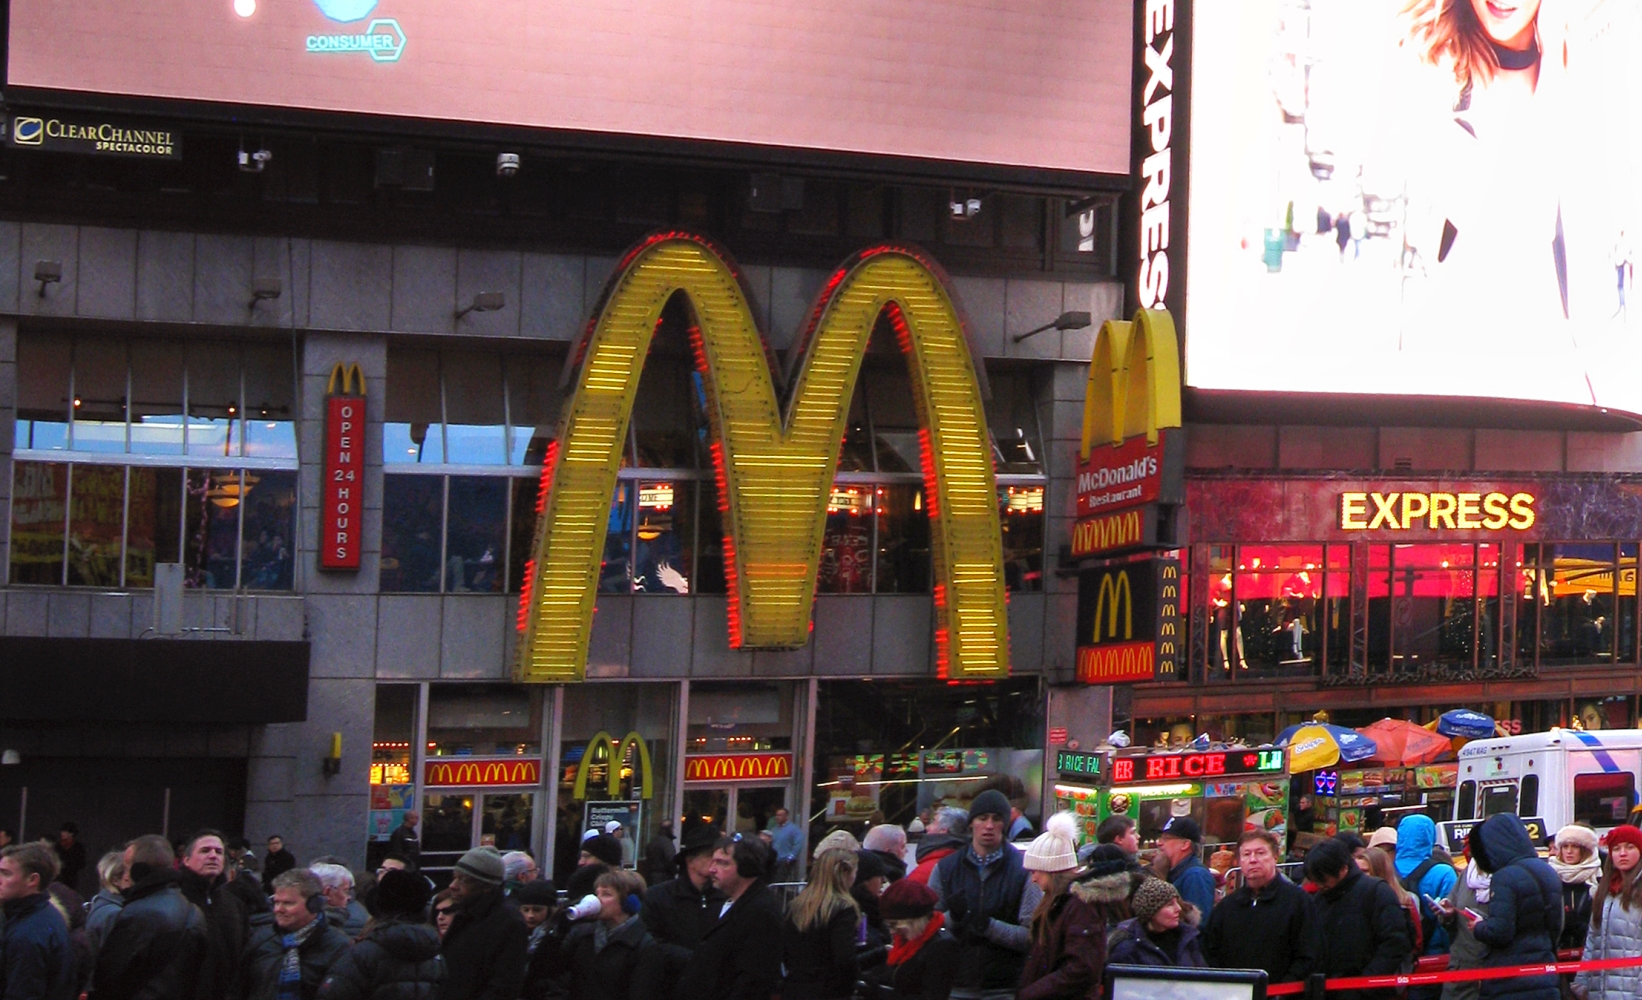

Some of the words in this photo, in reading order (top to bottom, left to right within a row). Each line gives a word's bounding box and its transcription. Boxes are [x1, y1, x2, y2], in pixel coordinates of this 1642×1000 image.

[306, 33, 394, 52] CONSUMER
[96, 142, 172, 154] SPECTACOLOR
[339, 406, 353, 464] OPEN
[333, 469, 355, 482] 24
[1078, 455, 1157, 494] McDonald's
[1089, 484, 1142, 508] Restaurant
[336, 487, 350, 558] HOURS
[1341, 492, 1535, 530] EXPRESS
[1147, 753, 1226, 778] RICE
